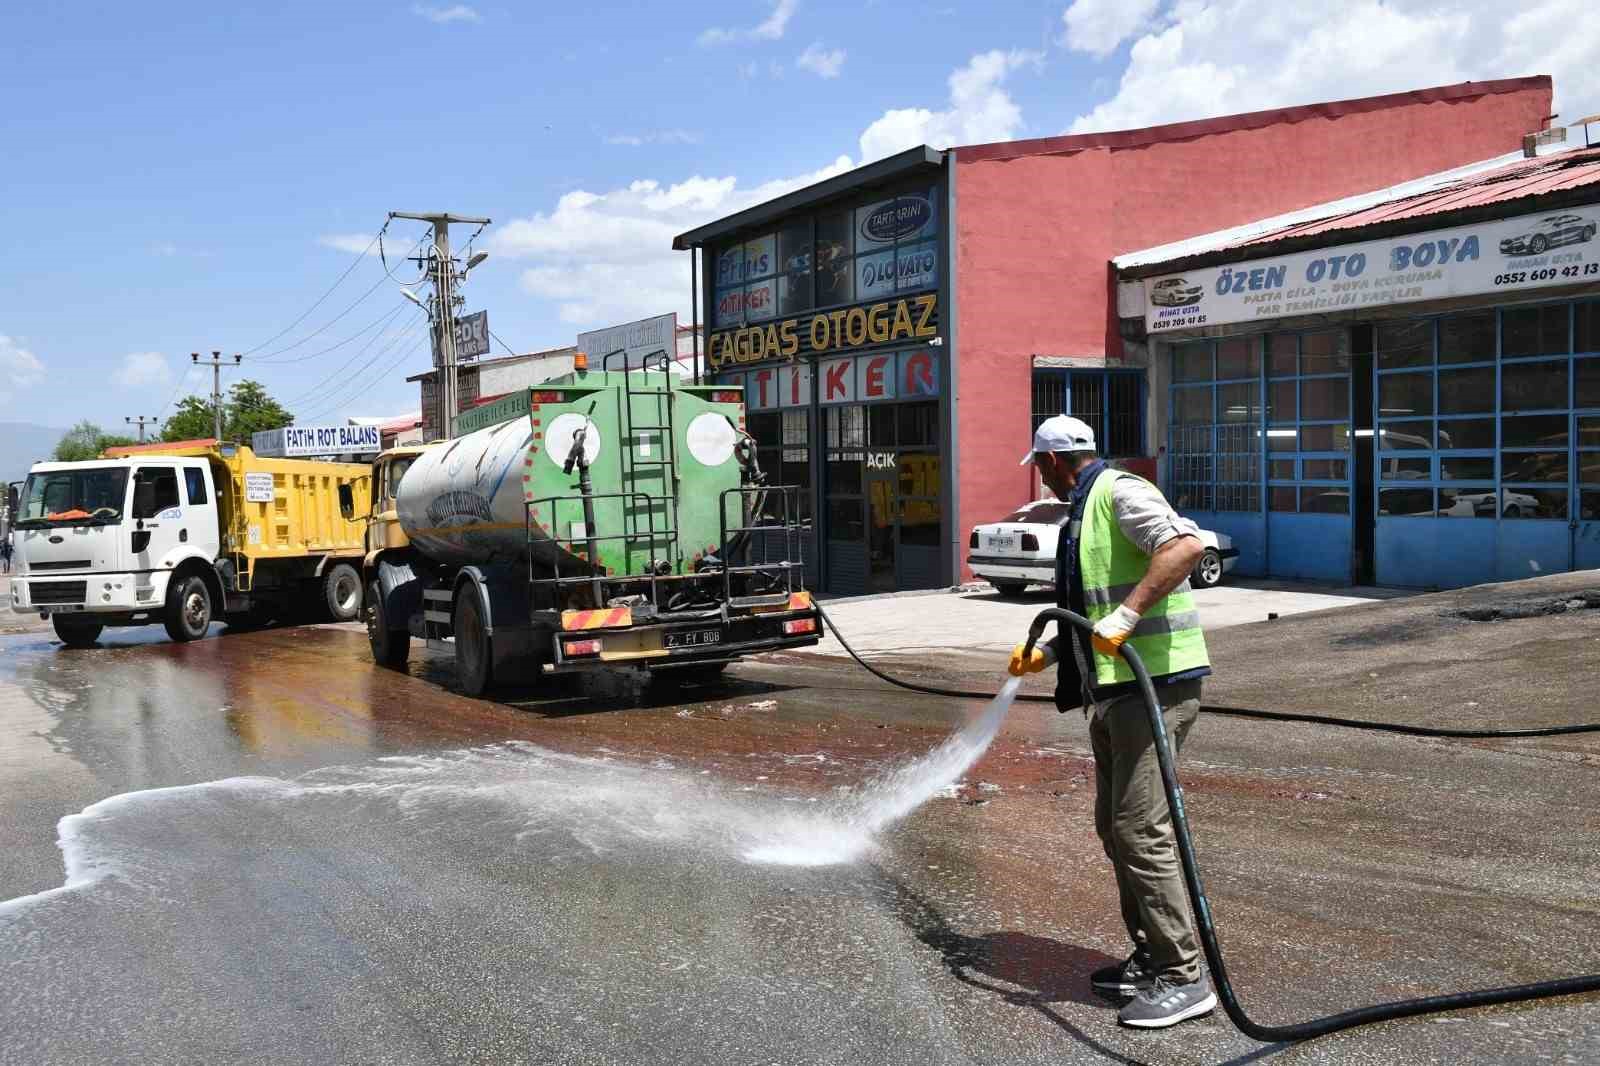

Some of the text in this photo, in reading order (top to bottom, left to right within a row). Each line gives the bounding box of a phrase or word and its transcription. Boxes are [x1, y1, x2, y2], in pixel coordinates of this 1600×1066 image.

[1215, 235, 1479, 296] ÖZEN OTO BOYA
[1494, 263, 1599, 285] 0552 609 42 13
[1244, 293, 1281, 305] PASTA
[708, 320, 798, 373] ÇAĞDAŞ
[811, 295, 937, 349] OTOGAZ
[317, 428, 337, 446] ROT
[340, 427, 378, 446] BALANS
[866, 451, 896, 470] AÇIK
